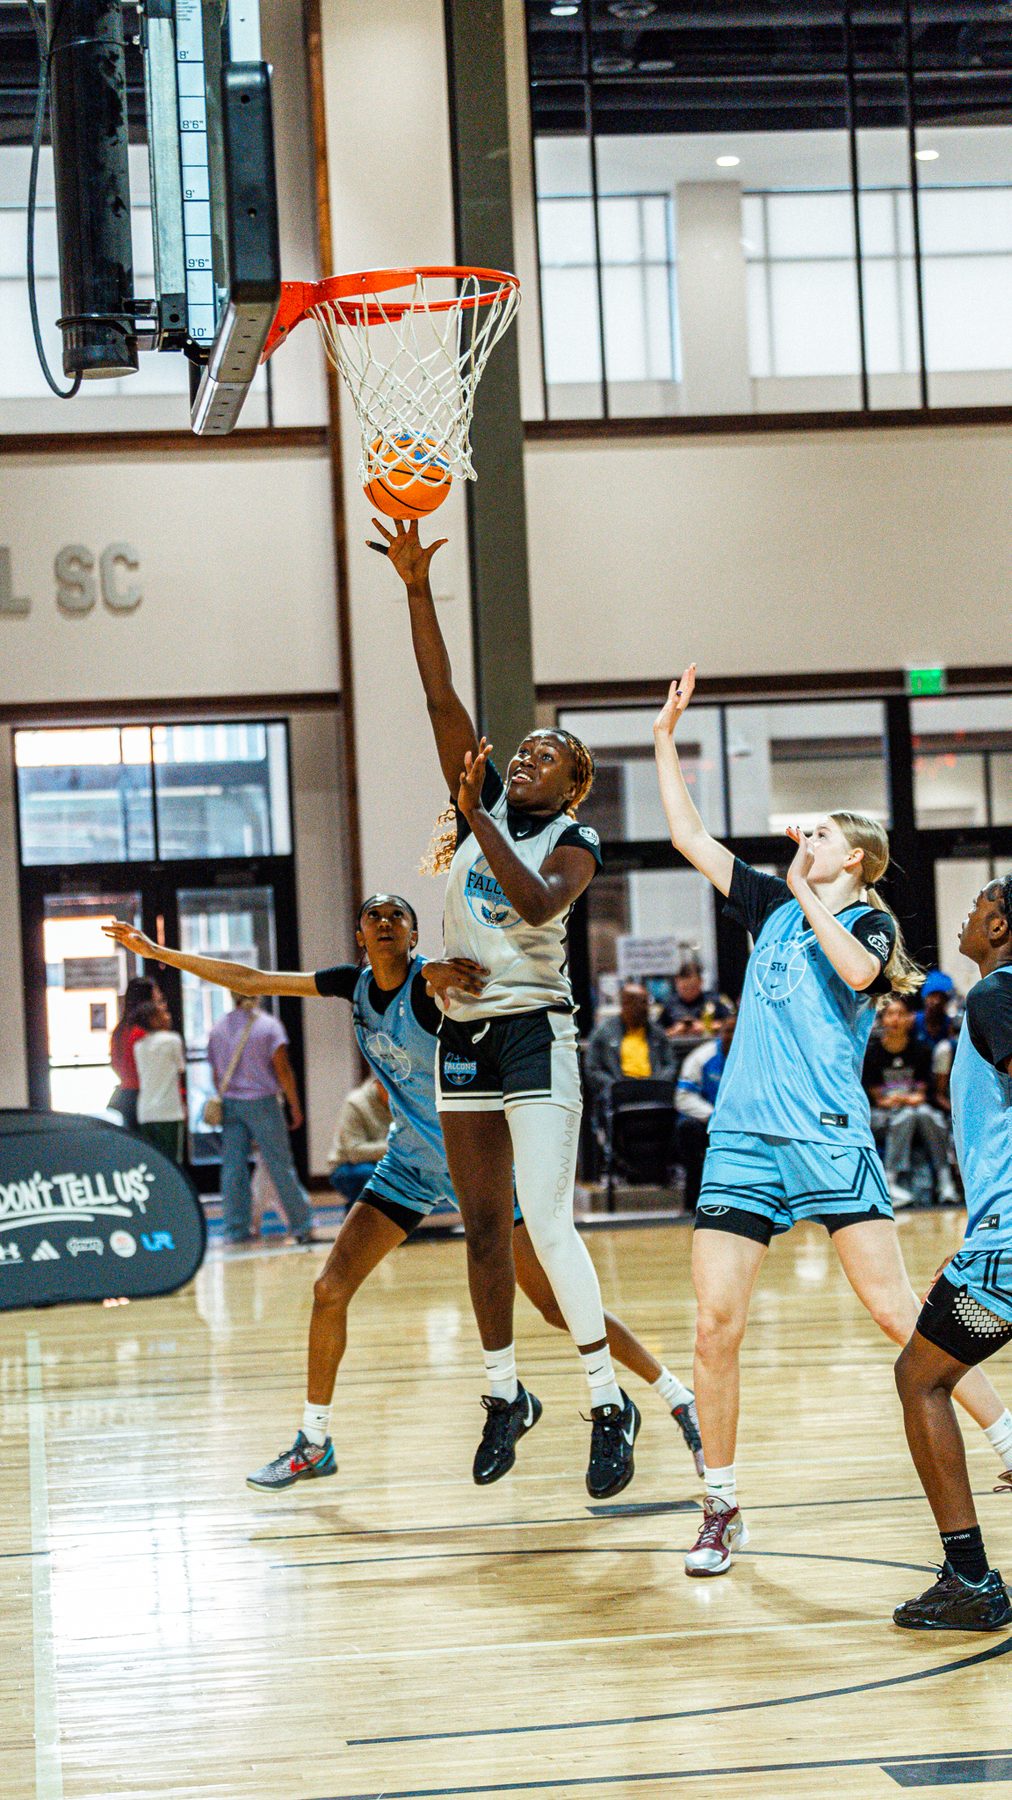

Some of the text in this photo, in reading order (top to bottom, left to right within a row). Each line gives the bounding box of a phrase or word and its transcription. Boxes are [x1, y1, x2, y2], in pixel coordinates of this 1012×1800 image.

[179, 51, 189, 60] 8'
[185, 189, 195, 199] 9'
[188, 258, 210, 268] 9'6"
[191, 327, 207, 337] 10'
[54, 544, 142, 618] SC
[467, 871, 505, 896] FALC
[444, 1061, 477, 1070] FALCONS
[51, 1172, 119, 1209] TELL
